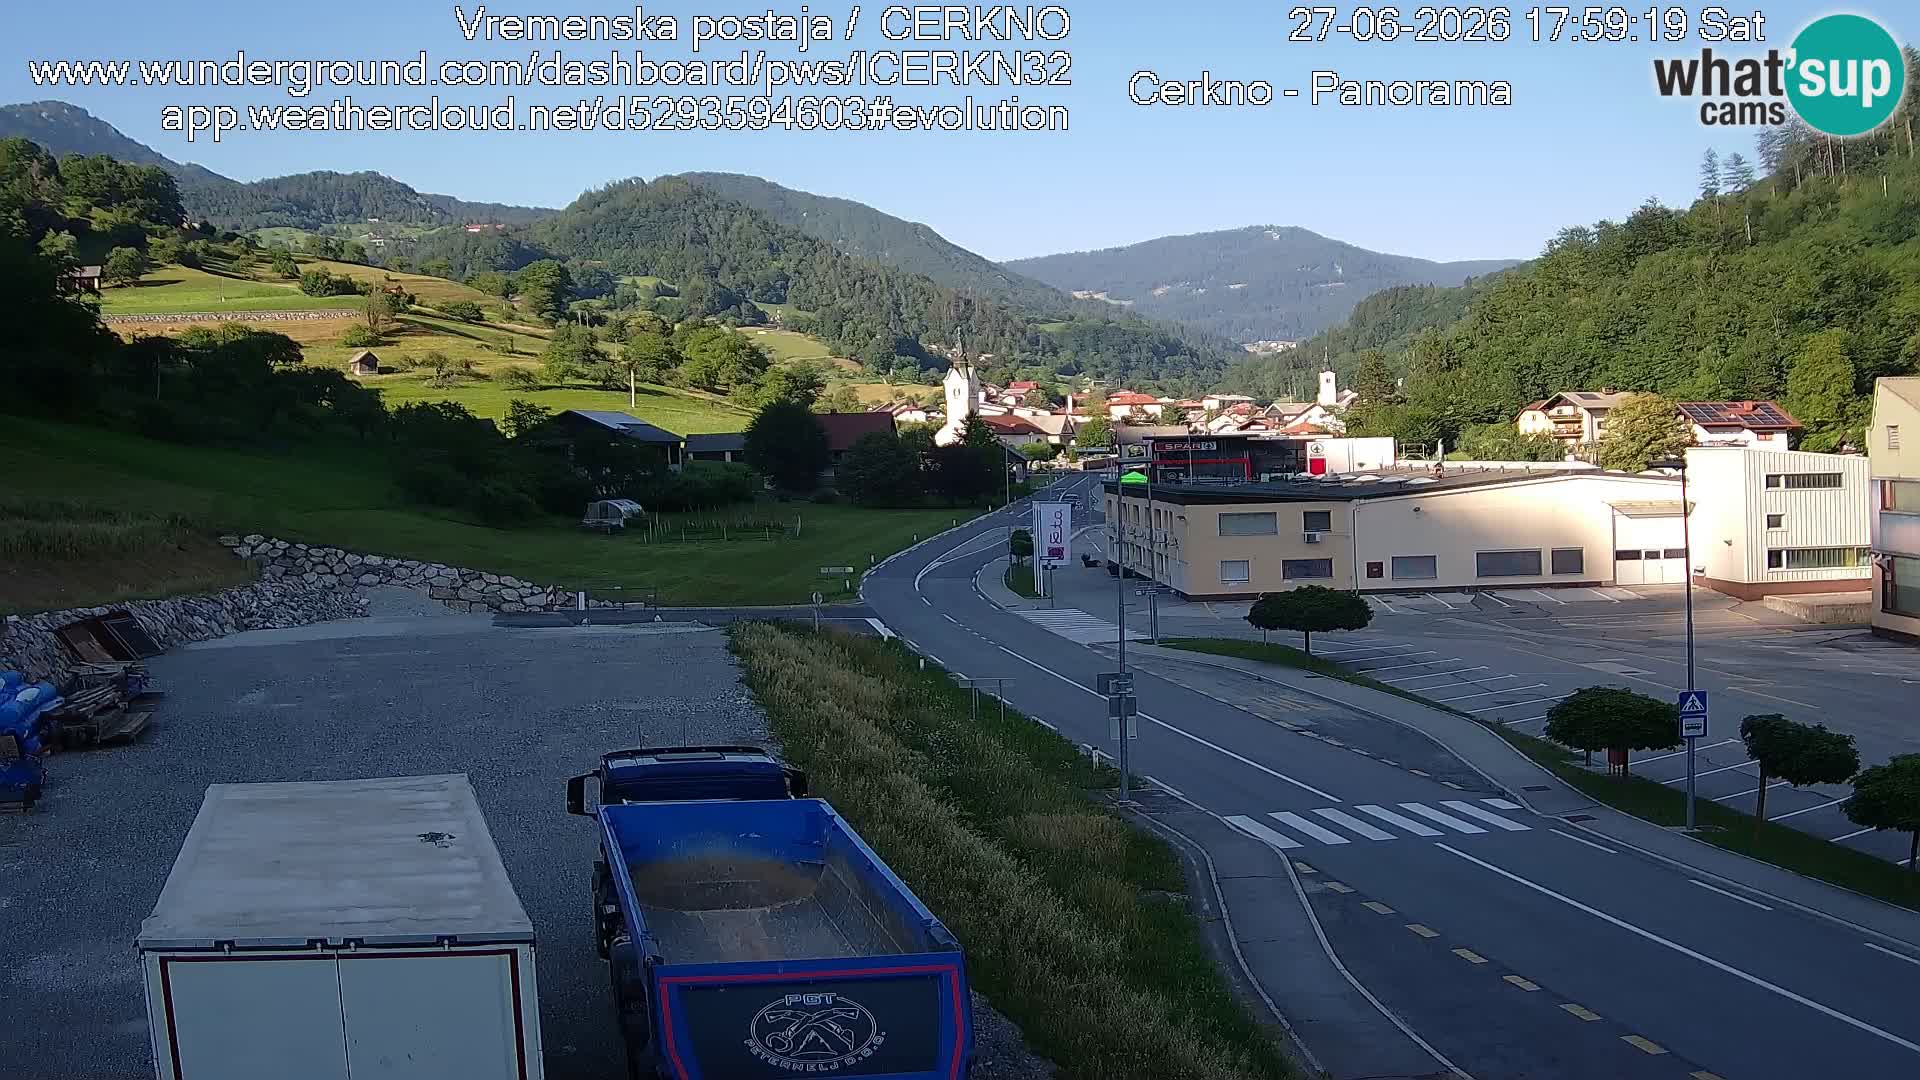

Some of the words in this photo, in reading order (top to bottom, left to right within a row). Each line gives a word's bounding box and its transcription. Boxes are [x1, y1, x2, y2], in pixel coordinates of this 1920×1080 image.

[1165, 442, 1201, 451] SPAR
[784, 992, 837, 1007] PGT
[744, 1038, 840, 1072] PETERNELJ
